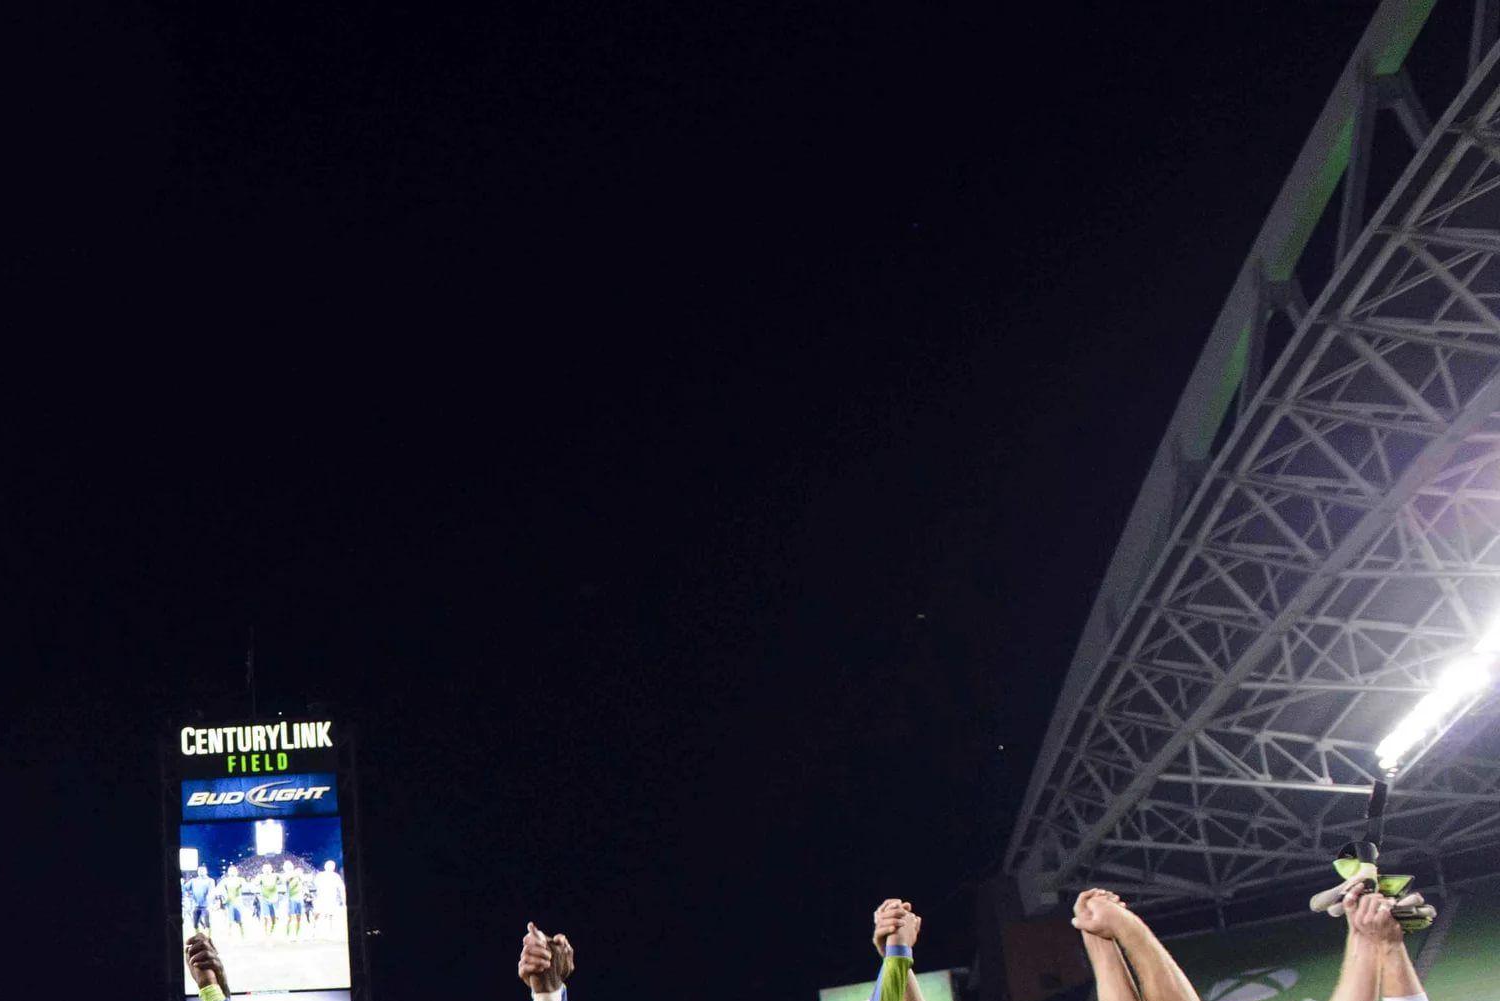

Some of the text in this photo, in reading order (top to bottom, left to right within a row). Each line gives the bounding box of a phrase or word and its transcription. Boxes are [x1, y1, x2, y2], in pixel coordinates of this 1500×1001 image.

[181, 721, 333, 756] CENTURYLINK
[227, 752, 288, 773] FIELD
[186, 786, 331, 807] BUD LIGHT
